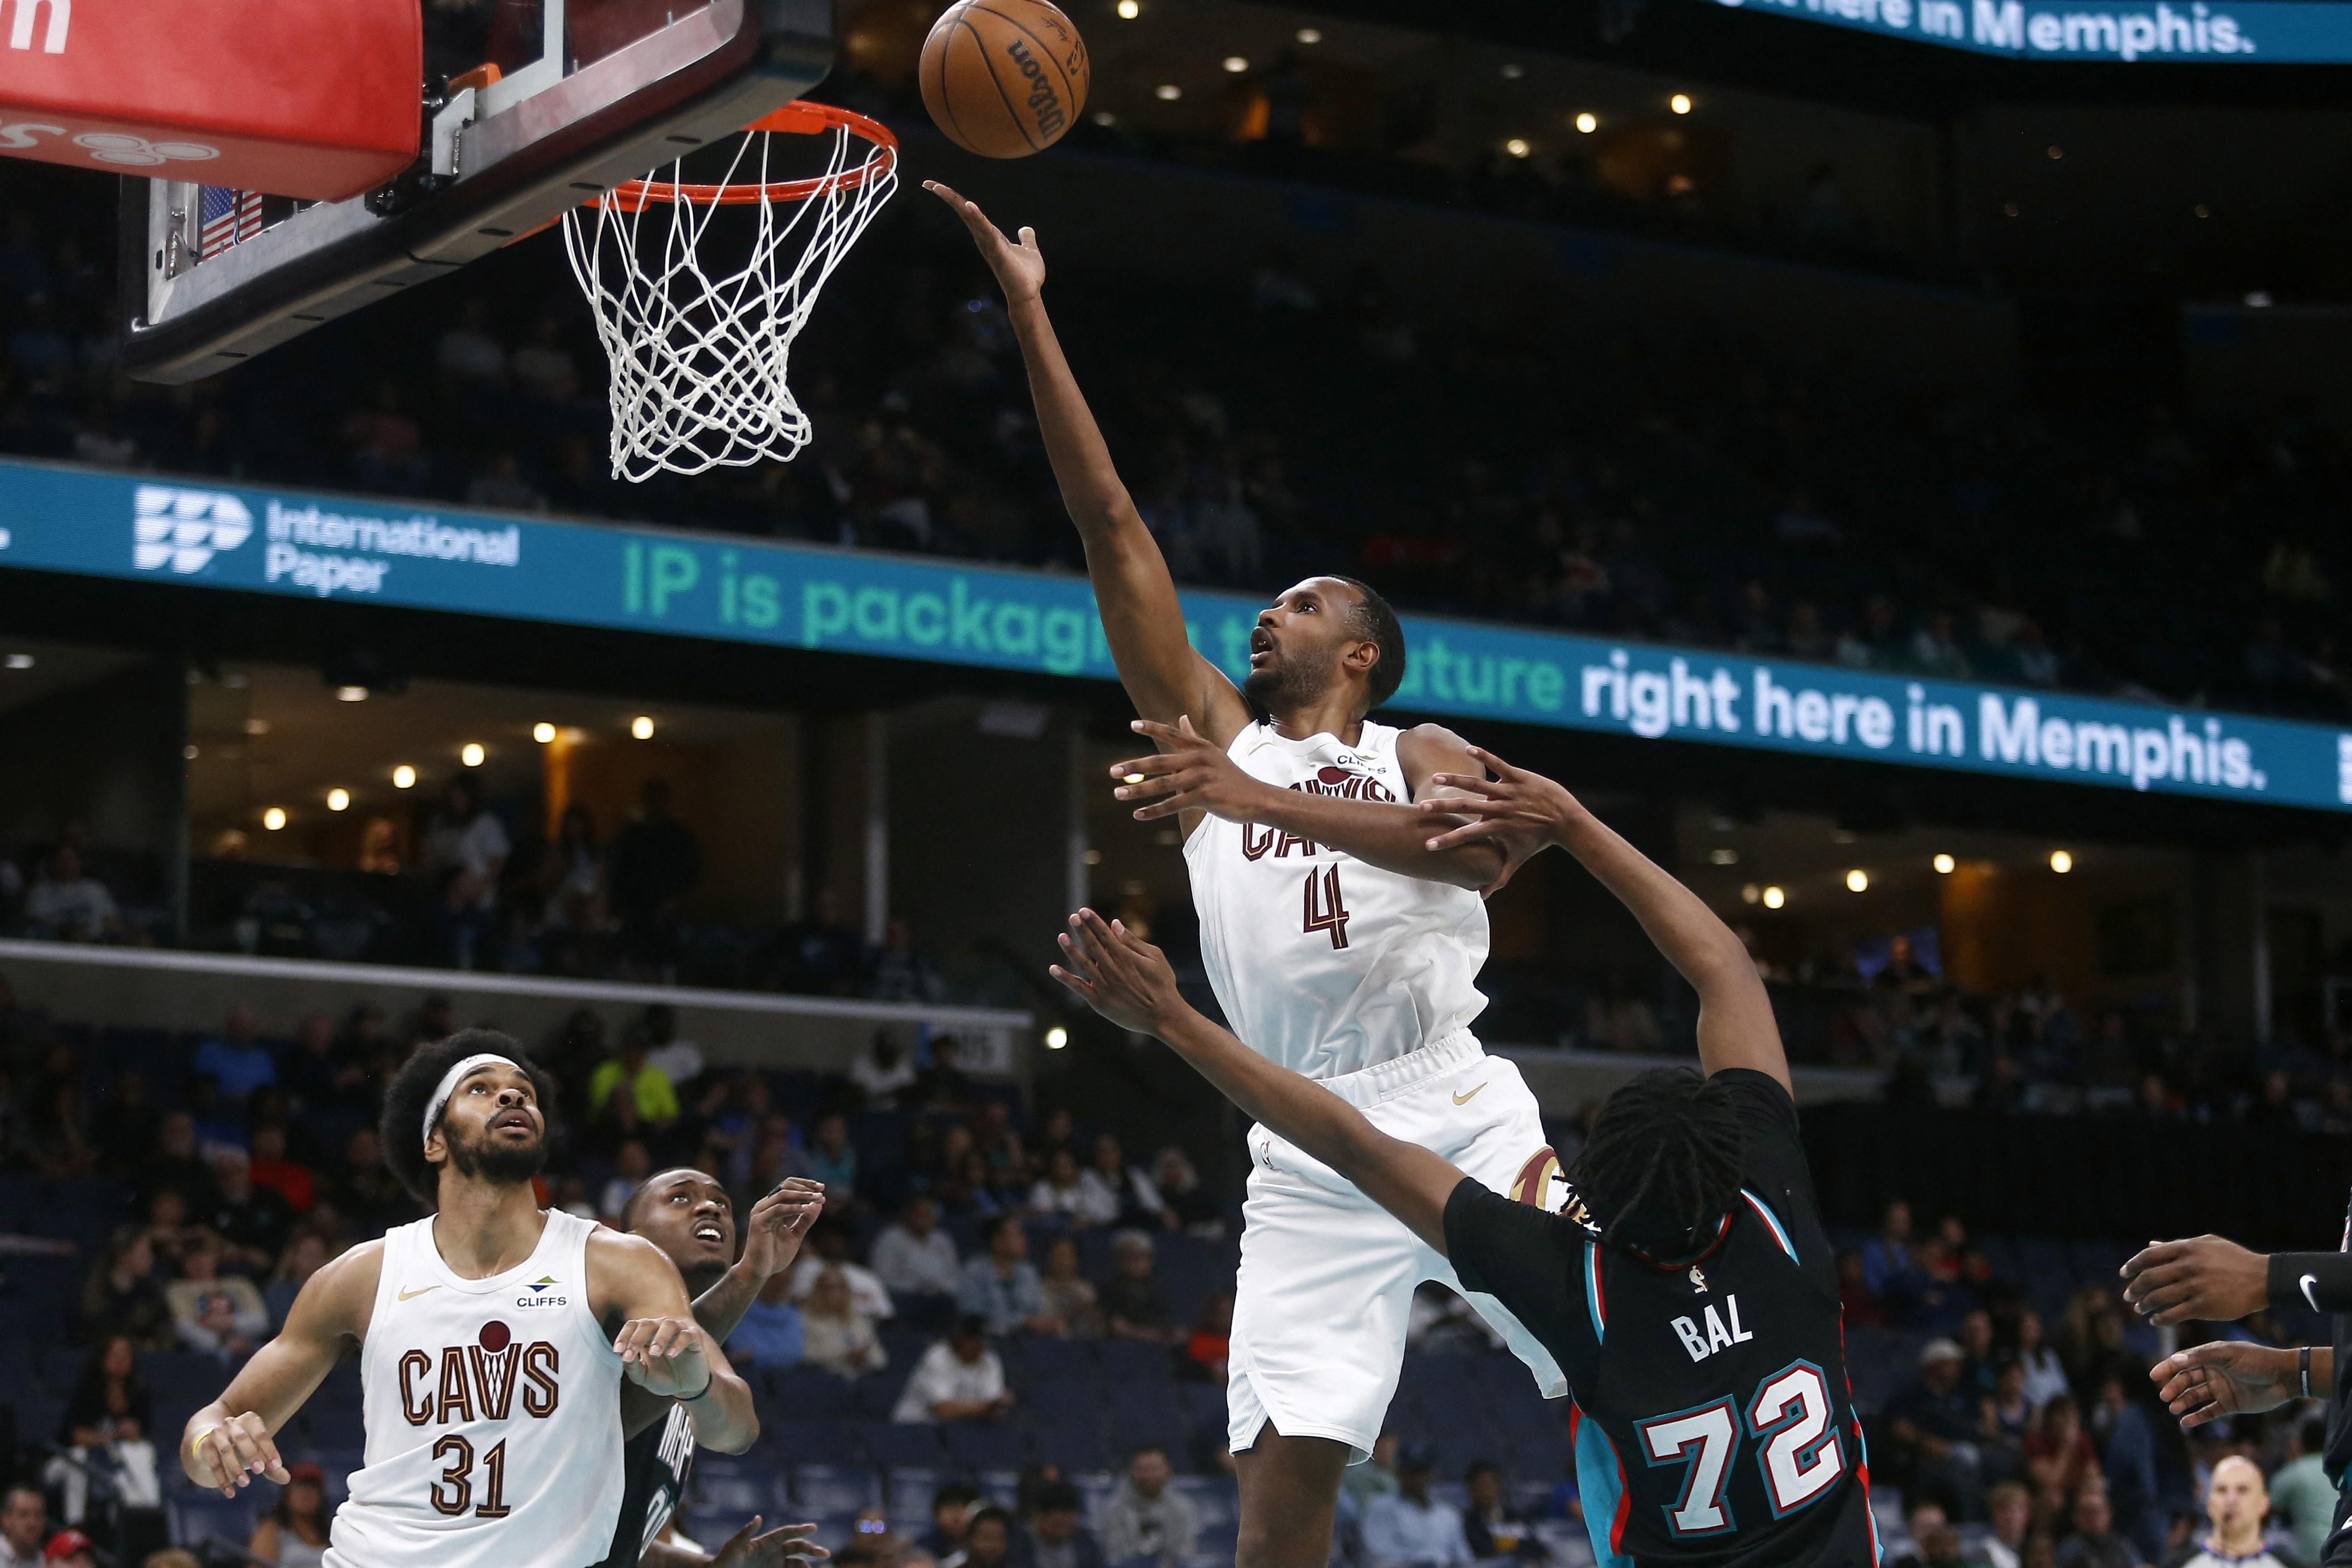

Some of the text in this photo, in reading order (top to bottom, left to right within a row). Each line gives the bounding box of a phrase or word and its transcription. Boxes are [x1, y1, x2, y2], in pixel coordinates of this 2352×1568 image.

[1972, 0, 2256, 61] Memphis.
[1007, 38, 1065, 140] Wilson
[266, 501, 520, 567] International
[266, 543, 389, 598] Paper
[624, 544, 699, 617] IP
[720, 550, 782, 627] is
[1397, 638, 2266, 791] uture right here in Memphis.
[1303, 862, 1349, 950] 4
[517, 1296, 567, 1307] CLIFFS
[1671, 1294, 1753, 1362] BAL
[399, 1341, 559, 1426] CAVS
[430, 1434, 511, 1518] 31
[1633, 1358, 1848, 1539] 72
